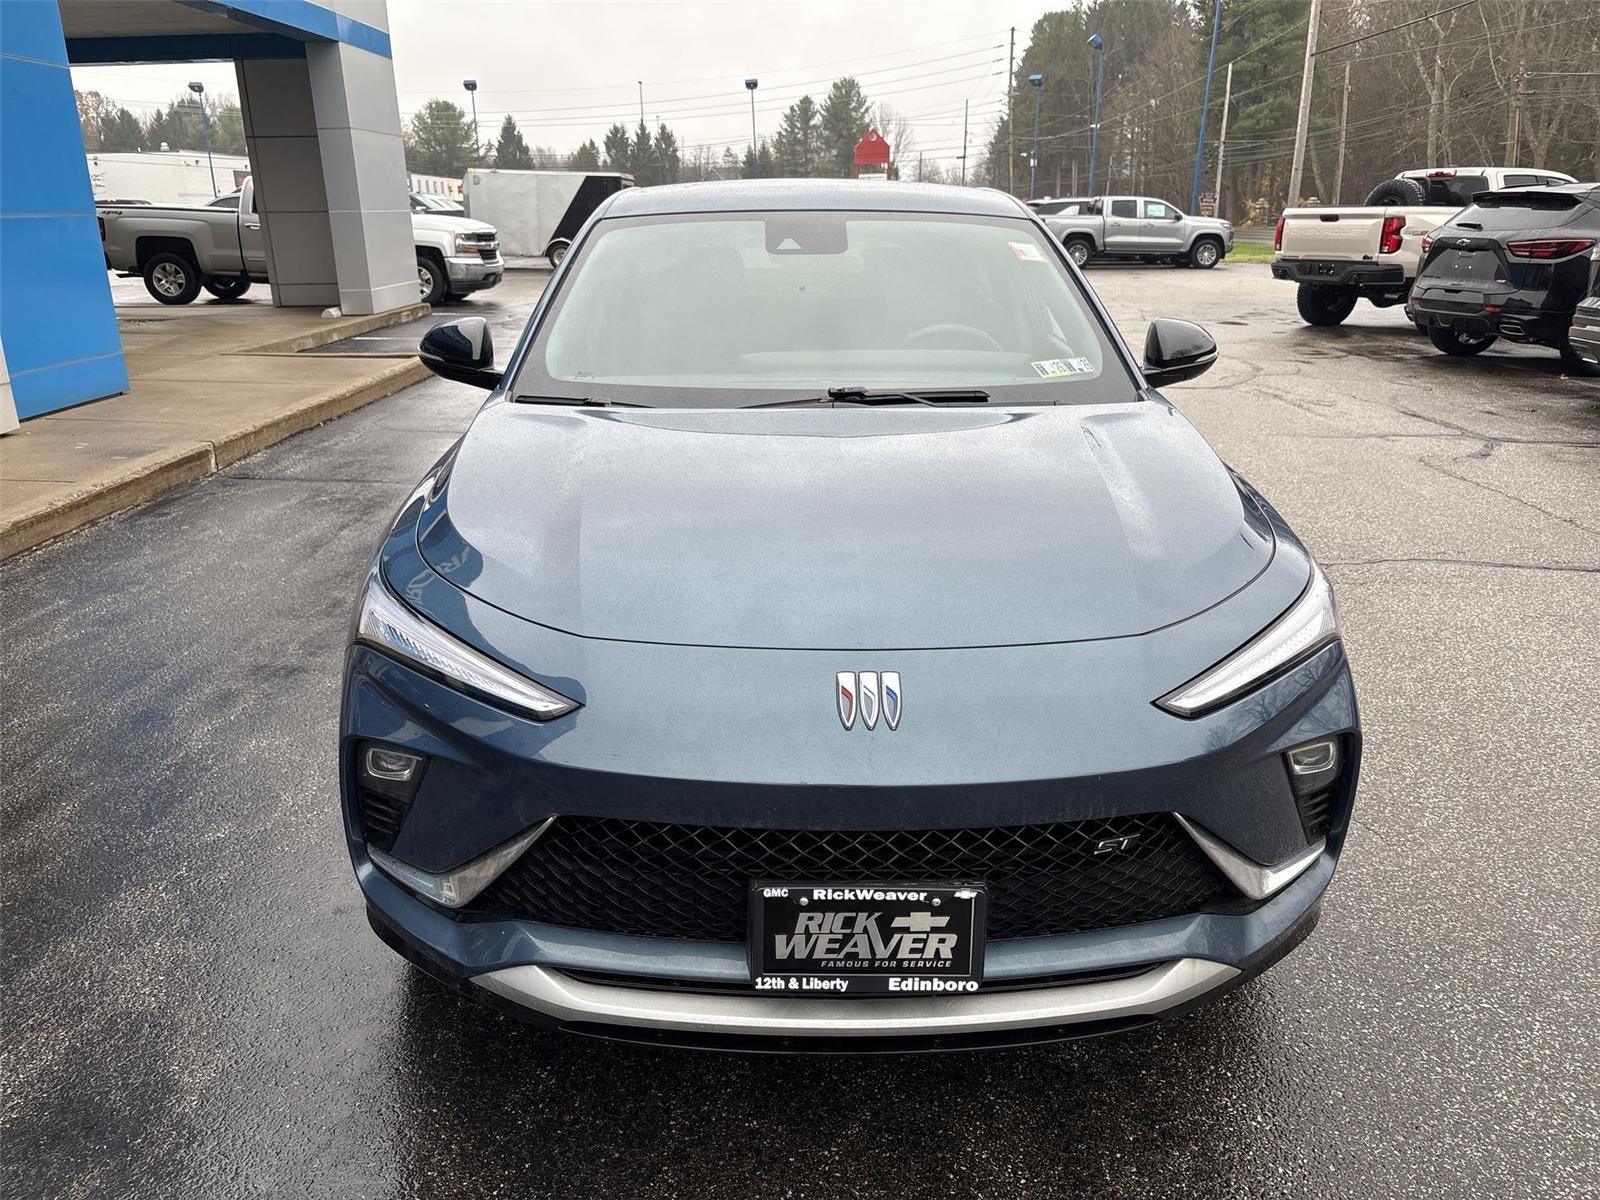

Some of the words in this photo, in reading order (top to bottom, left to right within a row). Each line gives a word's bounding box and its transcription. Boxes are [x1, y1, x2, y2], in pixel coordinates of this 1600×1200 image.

[763, 888, 789, 898] GMC
[813, 889, 927, 901] RickWeaver
[794, 911, 884, 934] RICK
[774, 933, 958, 960] WEAVER
[820, 960, 869, 968] FAMOUS
[875, 960, 897, 968] FOR
[902, 960, 952, 968] SERVICE
[755, 977, 785, 990] 12th
[788, 978, 799, 990] &
[802, 977, 849, 992] Liberty
[888, 977, 979, 991] Edinboro
